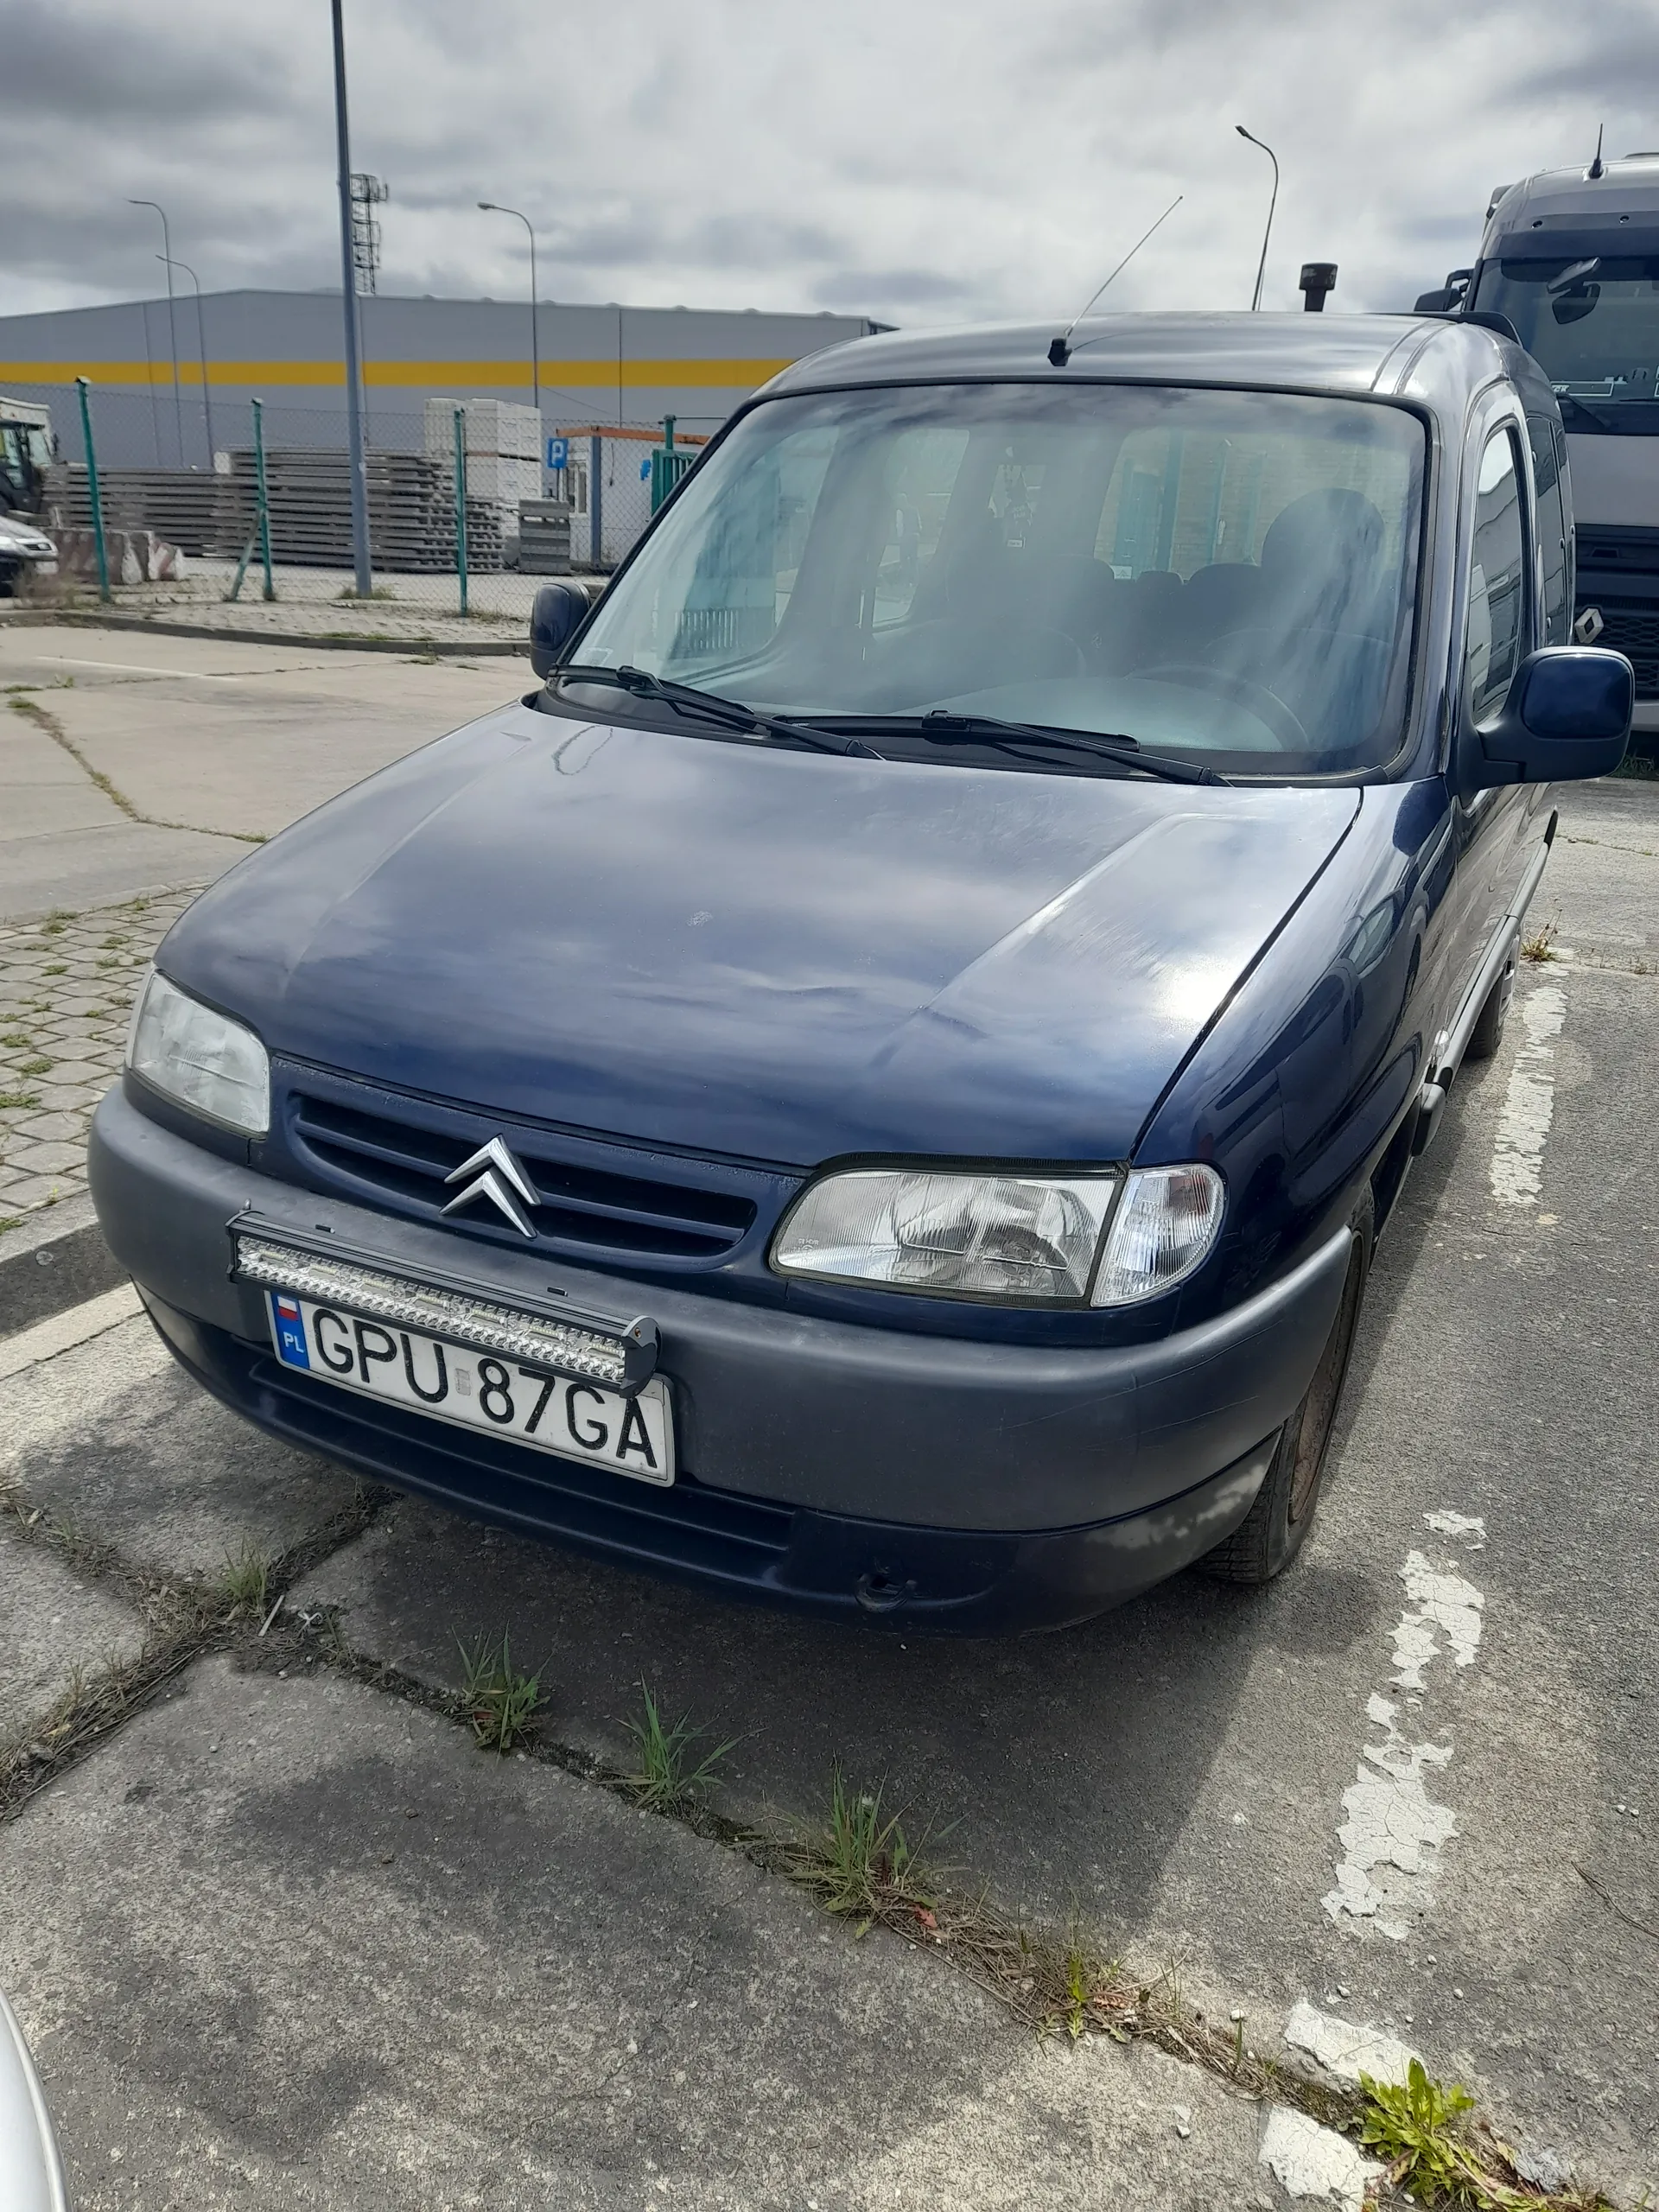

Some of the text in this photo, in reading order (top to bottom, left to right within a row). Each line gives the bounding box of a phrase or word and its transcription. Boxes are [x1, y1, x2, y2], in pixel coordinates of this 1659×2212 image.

[552, 441, 563, 466] P
[283, 1332, 304, 1353] PL
[312, 1308, 658, 1468] GPU 87GA
